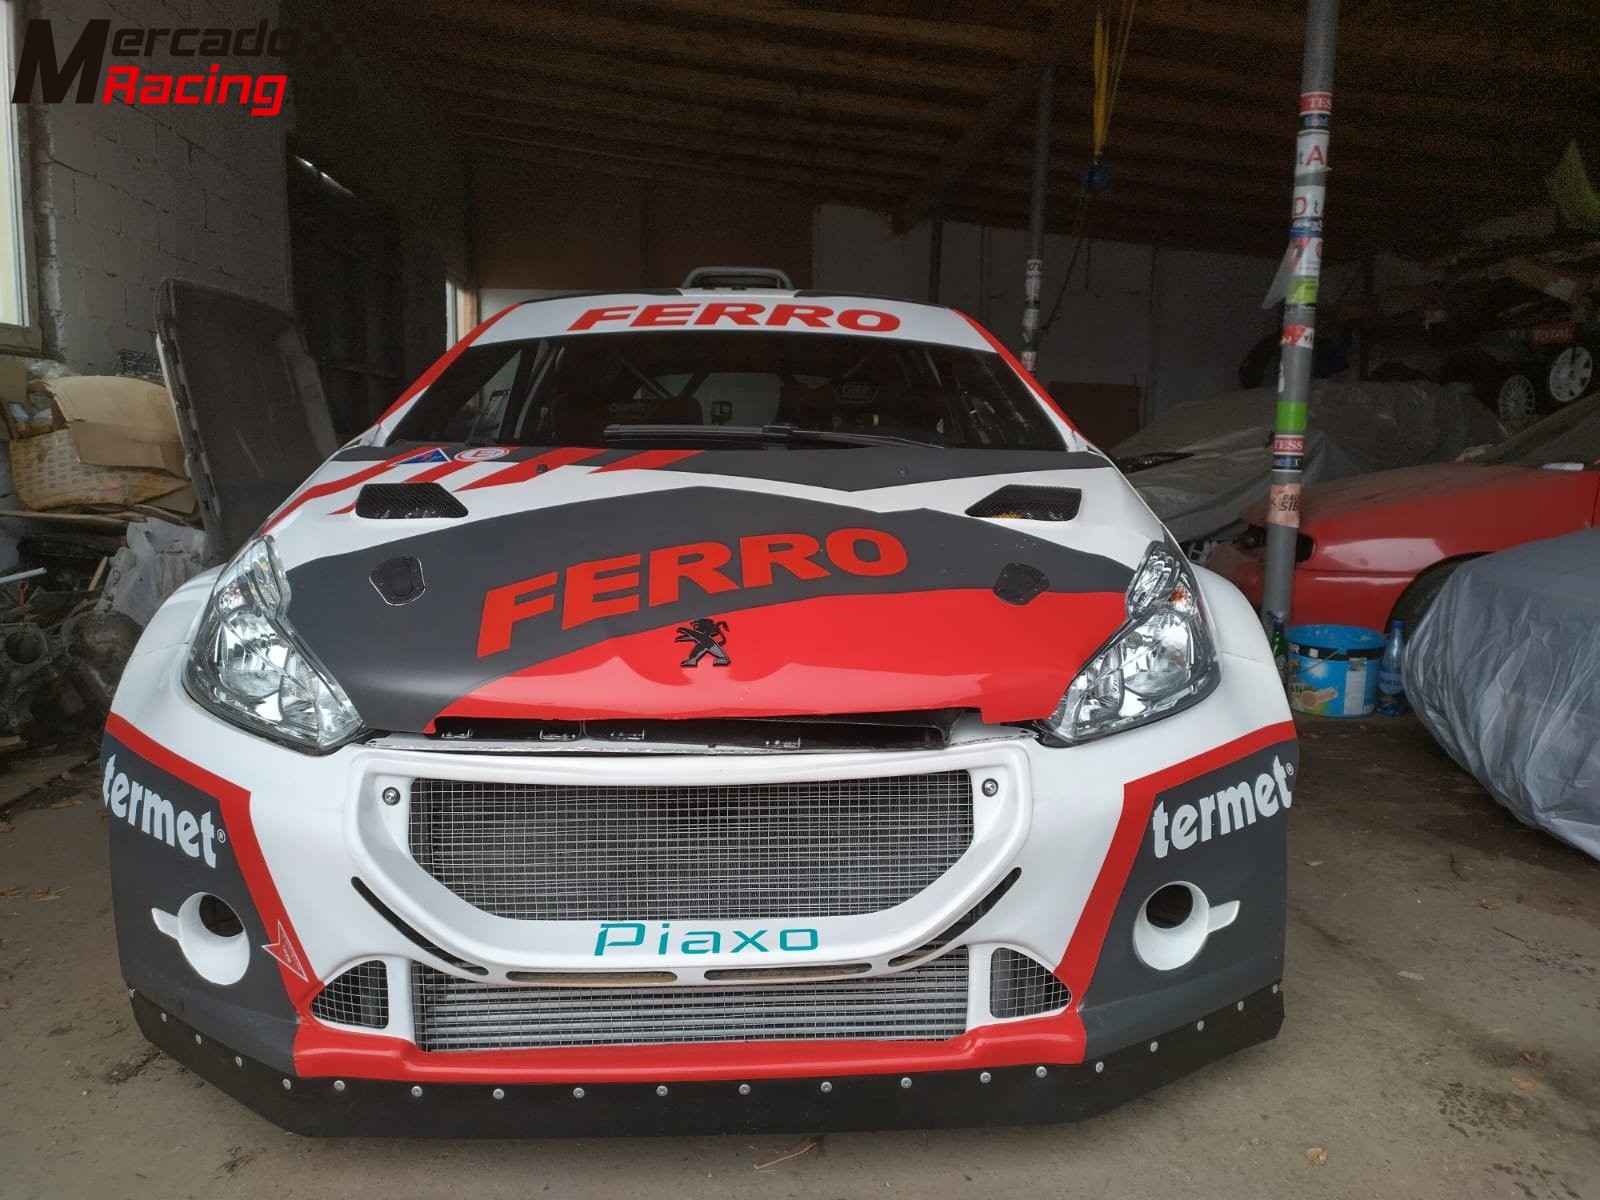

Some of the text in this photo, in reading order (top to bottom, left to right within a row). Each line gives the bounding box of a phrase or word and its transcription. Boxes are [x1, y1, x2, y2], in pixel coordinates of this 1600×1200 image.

[566, 303, 901, 332] FERRO
[476, 528, 908, 658] FERRO
[594, 922, 819, 956] Piaxo
